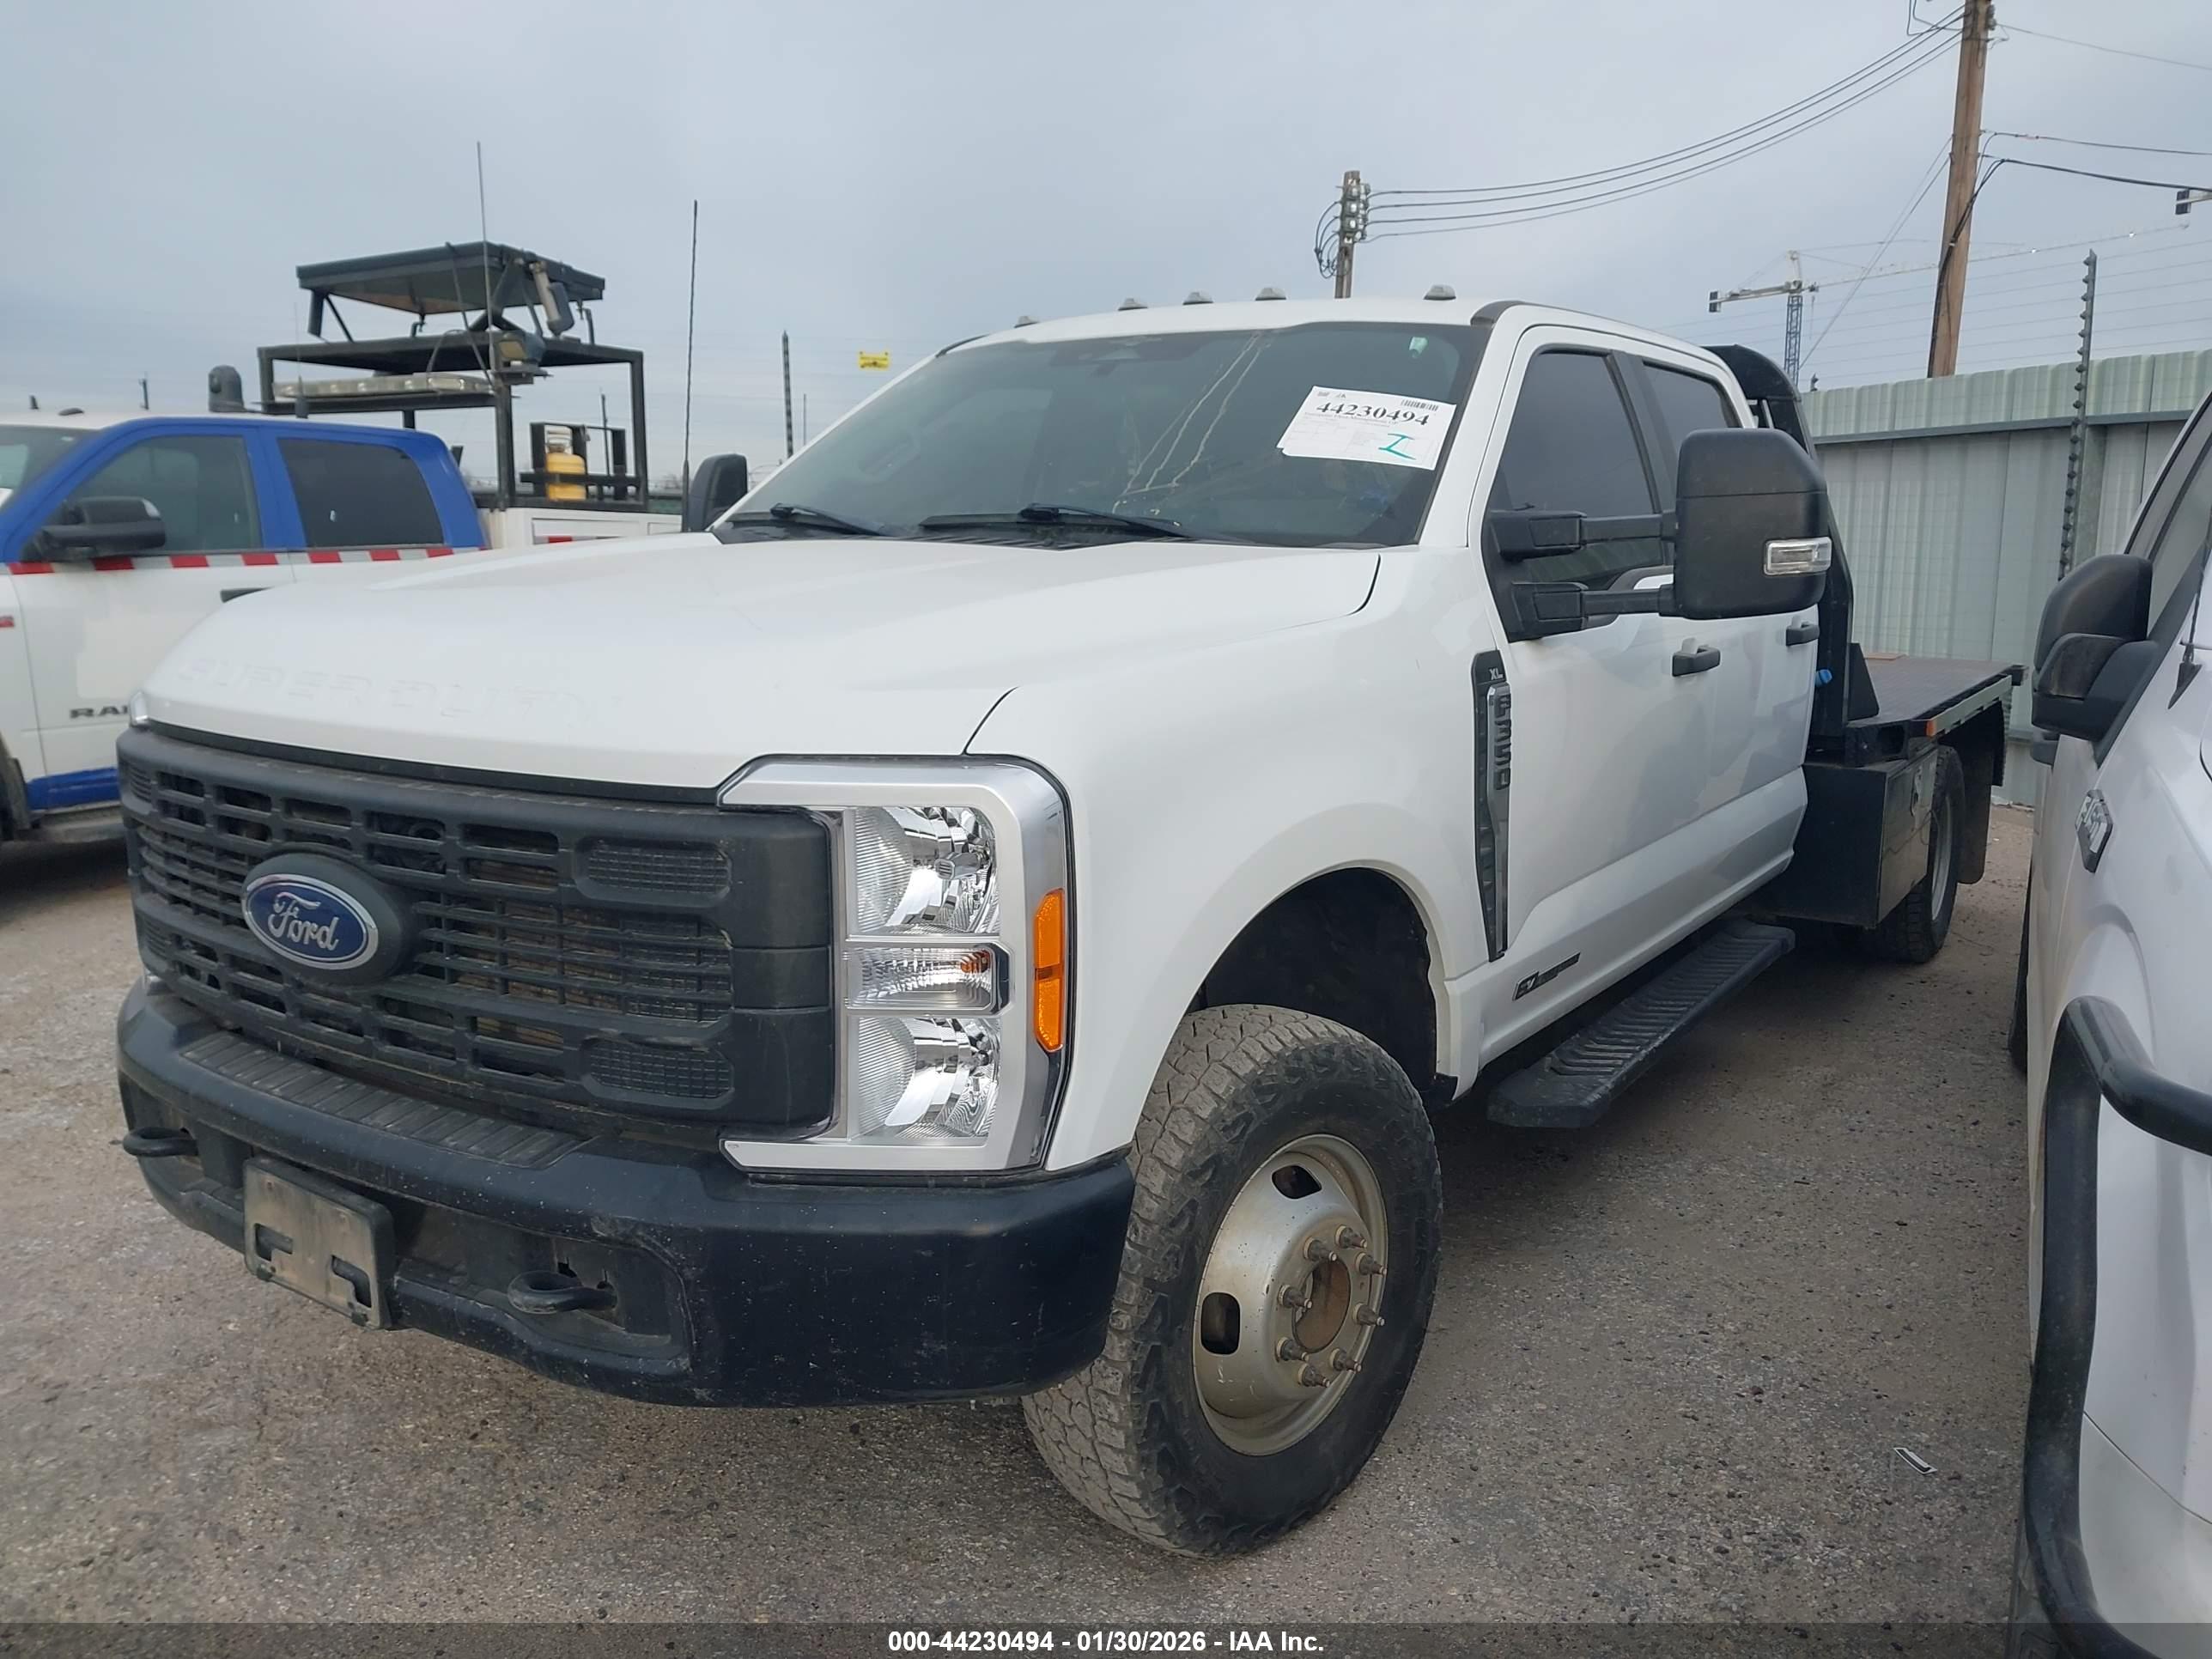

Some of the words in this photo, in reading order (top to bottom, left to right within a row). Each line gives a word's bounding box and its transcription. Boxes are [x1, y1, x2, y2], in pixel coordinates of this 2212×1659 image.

[1316, 402, 1430, 425] 44230494
[1489, 668, 1504, 681] XL
[70, 706, 129, 720] RA
[267, 891, 340, 951] Ford
